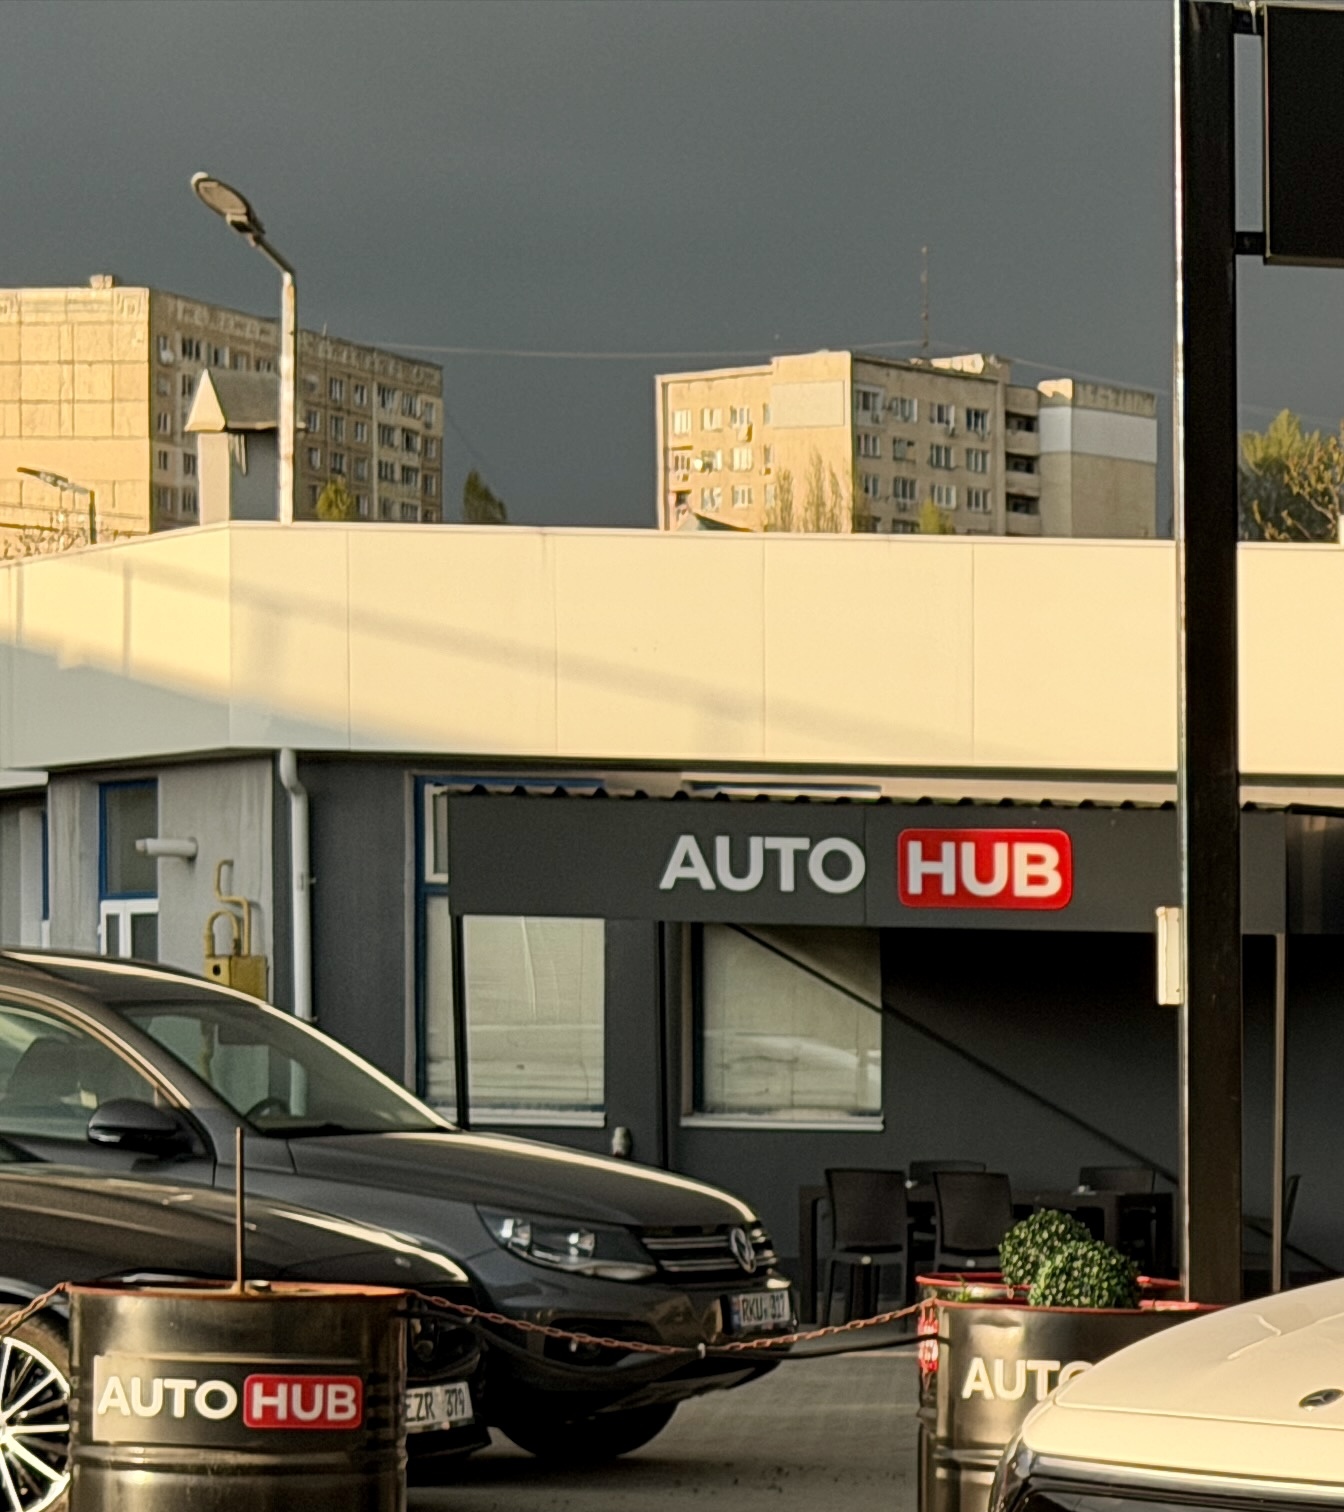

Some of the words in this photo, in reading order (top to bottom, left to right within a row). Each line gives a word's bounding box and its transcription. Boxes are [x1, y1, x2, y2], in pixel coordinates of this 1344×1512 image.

[658, 834, 866, 894] AUTO
[906, 840, 1063, 898] HUB
[97, 1375, 238, 1420] AUTO
[251, 1381, 357, 1422] HUB
